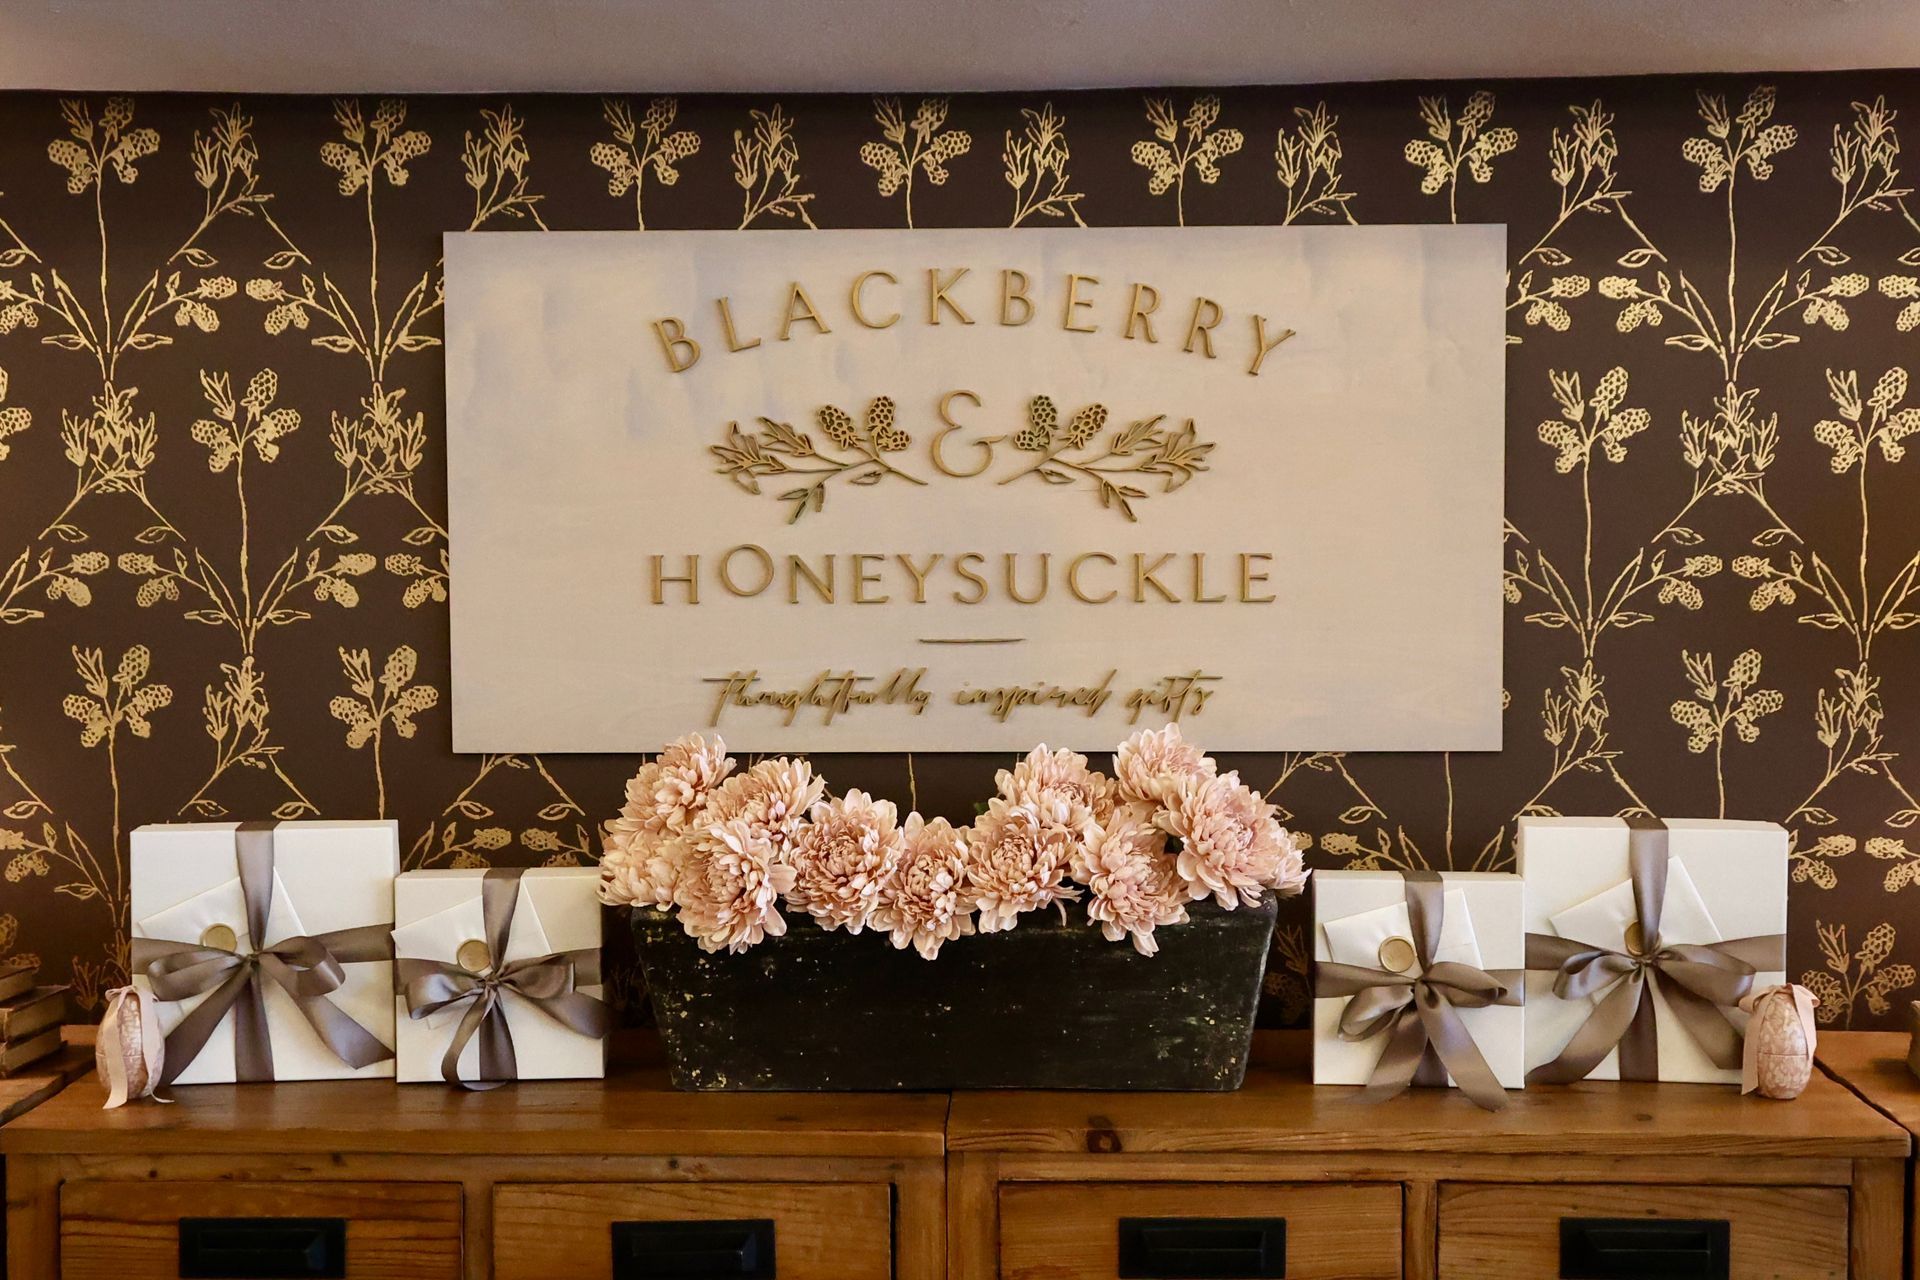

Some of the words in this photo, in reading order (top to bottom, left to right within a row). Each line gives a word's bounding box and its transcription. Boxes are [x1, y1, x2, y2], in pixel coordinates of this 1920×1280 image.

[652, 266, 1296, 376] BLACKBERRY
[932, 389, 1005, 478] &
[650, 543, 1277, 605] HONEYSUCKLE
[702, 667, 932, 727] thoughtfully
[954, 668, 1118, 724] inspired
[1127, 668, 1224, 725] gifts
